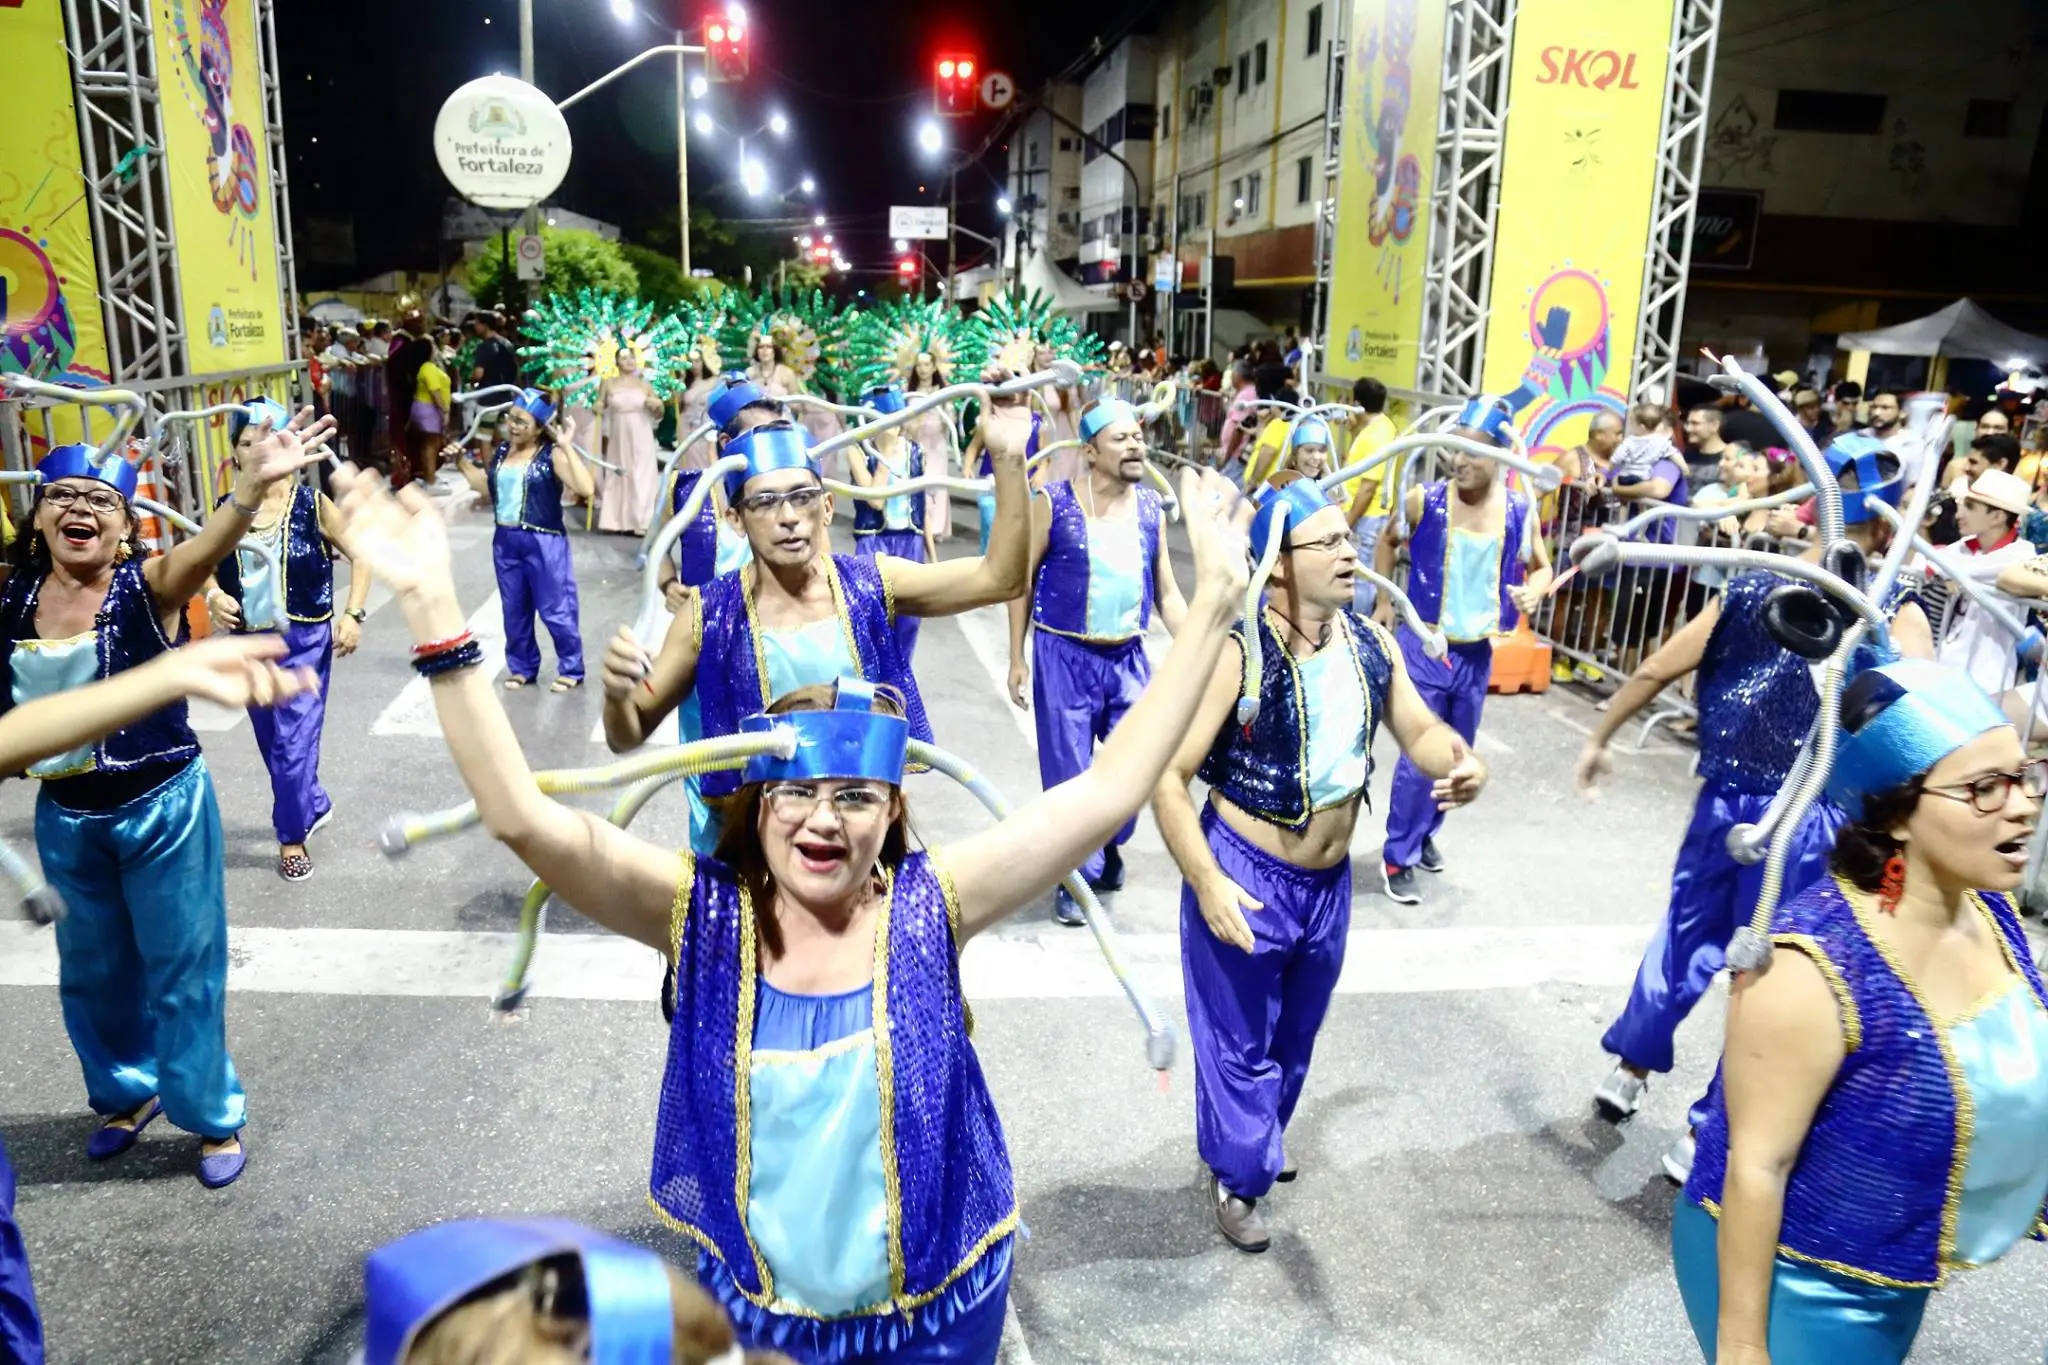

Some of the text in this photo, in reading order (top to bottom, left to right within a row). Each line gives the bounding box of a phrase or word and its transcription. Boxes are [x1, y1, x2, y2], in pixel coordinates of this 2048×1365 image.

[1536, 45, 1640, 91] SKOL
[455, 141, 544, 157] Prefeitura de
[458, 156, 544, 176] Fortaleza
[230, 322, 264, 338] Fortaleza
